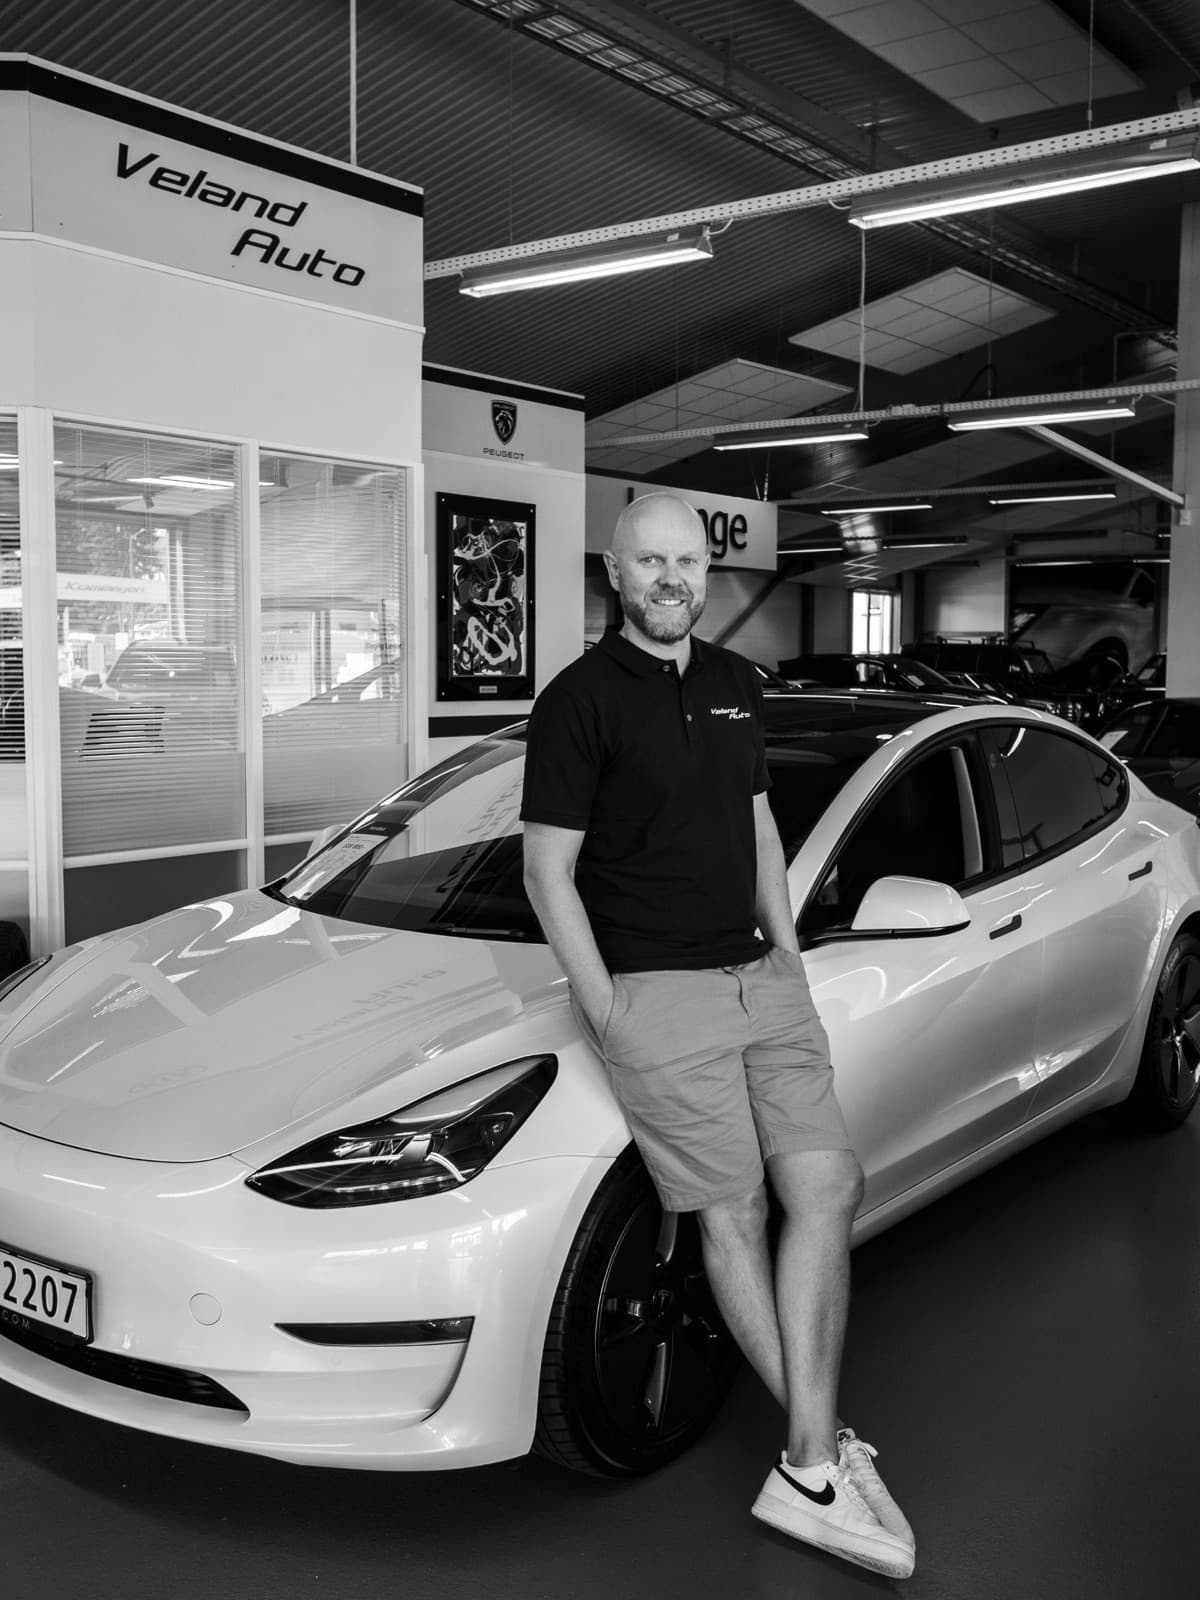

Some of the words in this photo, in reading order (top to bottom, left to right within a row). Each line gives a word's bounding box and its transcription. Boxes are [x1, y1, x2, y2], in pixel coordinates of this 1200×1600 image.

[116, 142, 309, 227] Veland
[230, 228, 366, 287] Auto
[483, 447, 525, 460] PEUGEOT
[710, 706, 739, 715] Veland
[728, 711, 751, 720] Auto
[3, 1260, 78, 1324] 2207
